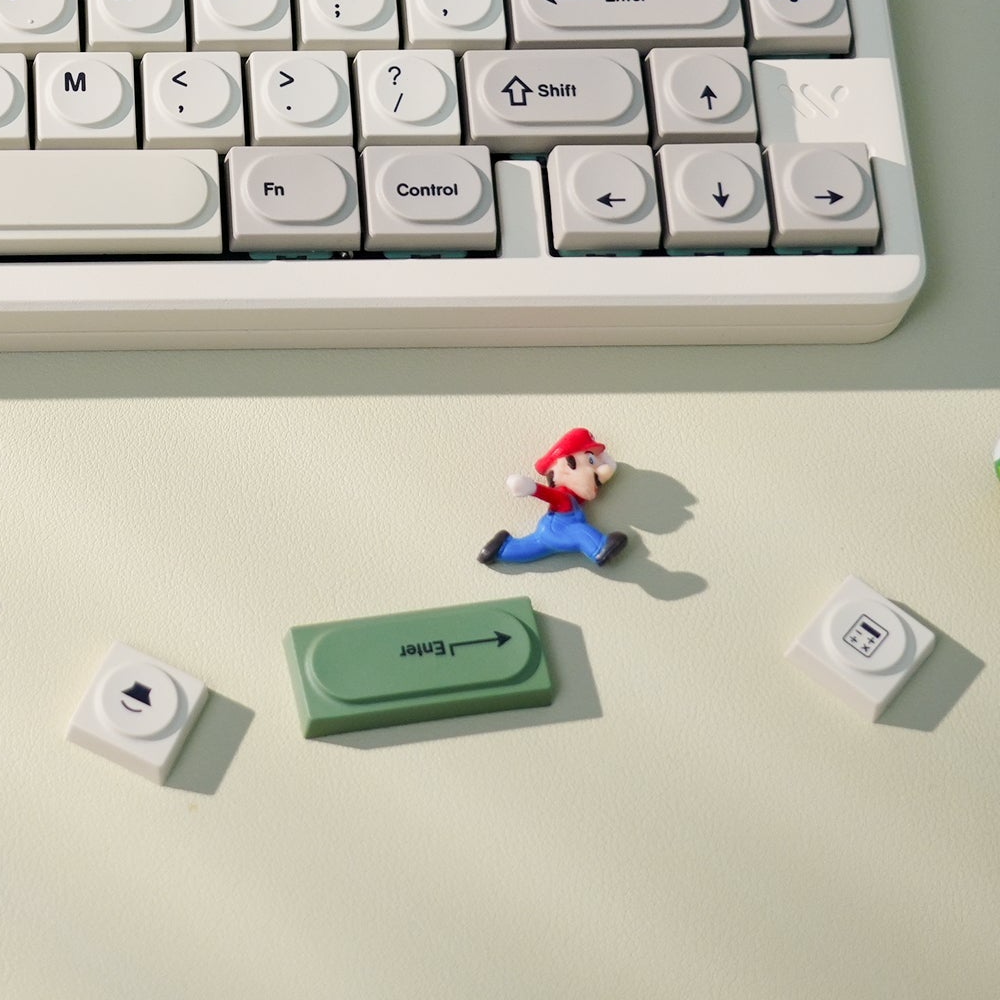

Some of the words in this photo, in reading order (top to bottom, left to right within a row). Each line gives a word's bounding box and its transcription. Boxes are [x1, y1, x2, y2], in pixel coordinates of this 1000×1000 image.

[65, 72, 86, 91] M
[172, 71, 187, 87] <
[280, 71, 294, 87] >
[388, 66, 401, 85] ?
[538, 84, 576, 97] Shift
[394, 93, 403, 112] /
[264, 183, 284, 196] Fn
[397, 183, 458, 196] Control
[400, 641, 446, 656] Enter
